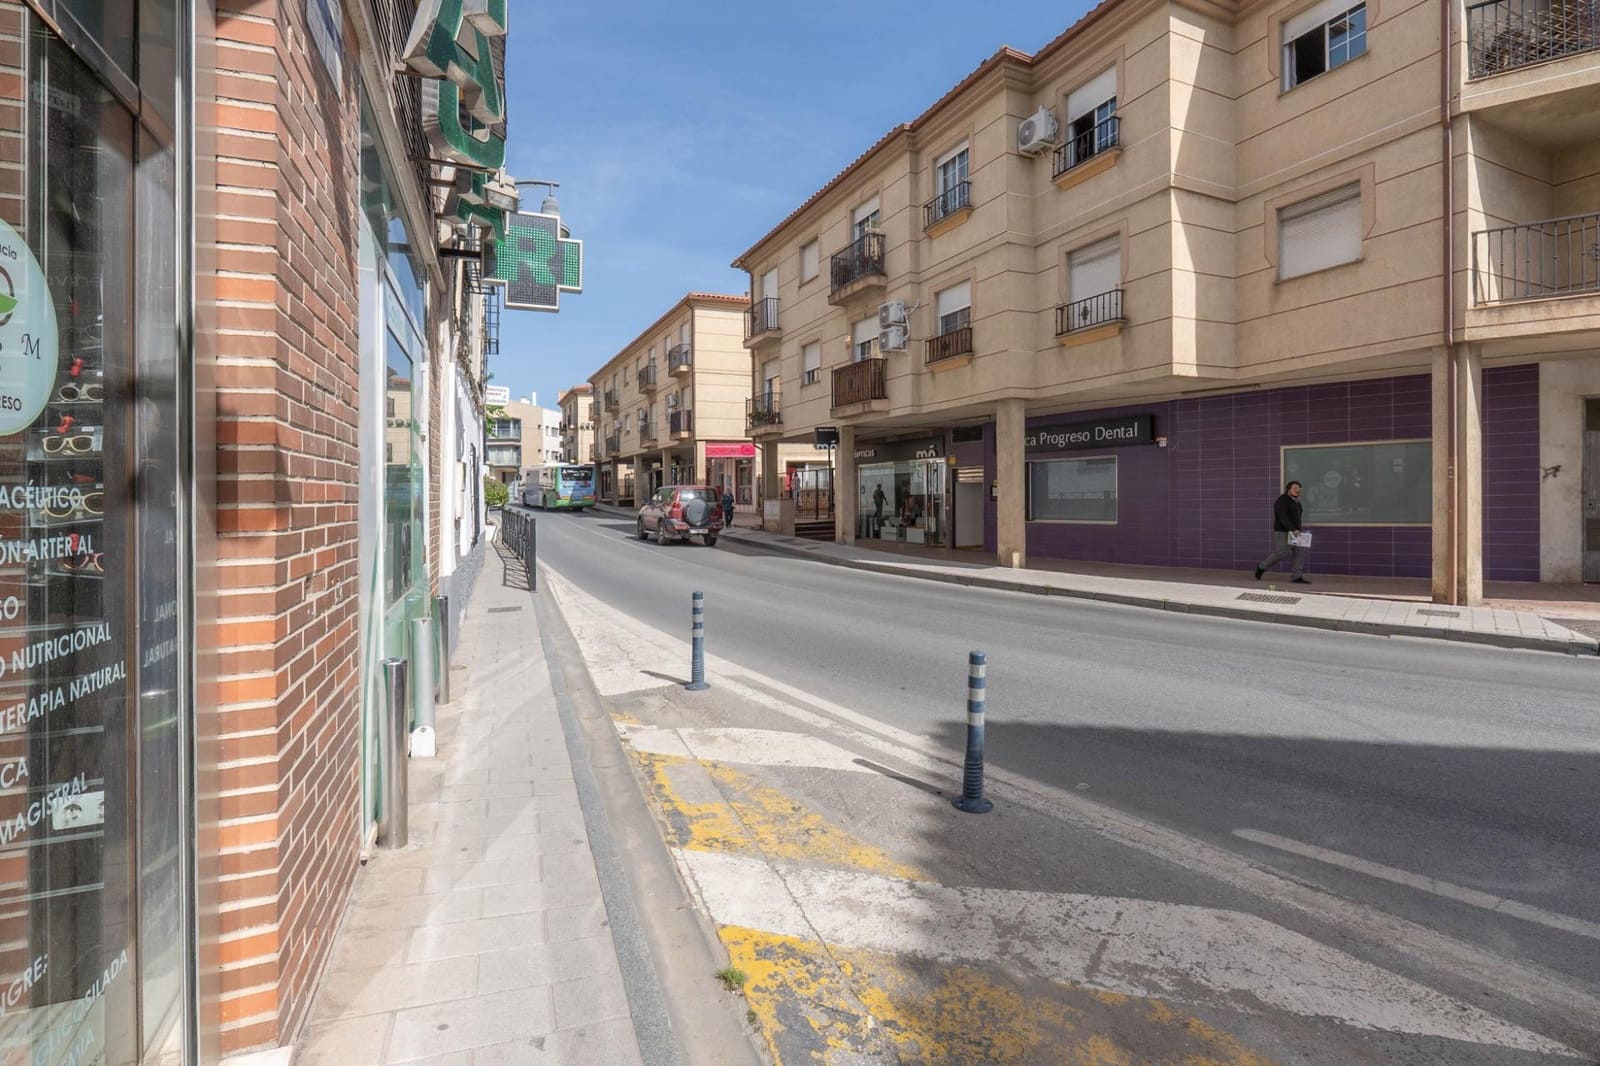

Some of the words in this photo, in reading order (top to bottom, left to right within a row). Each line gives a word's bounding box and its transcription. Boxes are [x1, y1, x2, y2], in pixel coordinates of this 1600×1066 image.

[0, 244, 17, 260] cia
[21, 333, 41, 360] M
[0, 394, 22, 412] ESO
[1040, 432, 1090, 448] Progreso
[1095, 421, 1138, 441] Dental
[0, 596, 19, 620] O
[12, 622, 111, 673] NUTRICIONAL
[69, 660, 126, 702] NATURAL
[0, 772, 88, 847] MAGISTRAL
